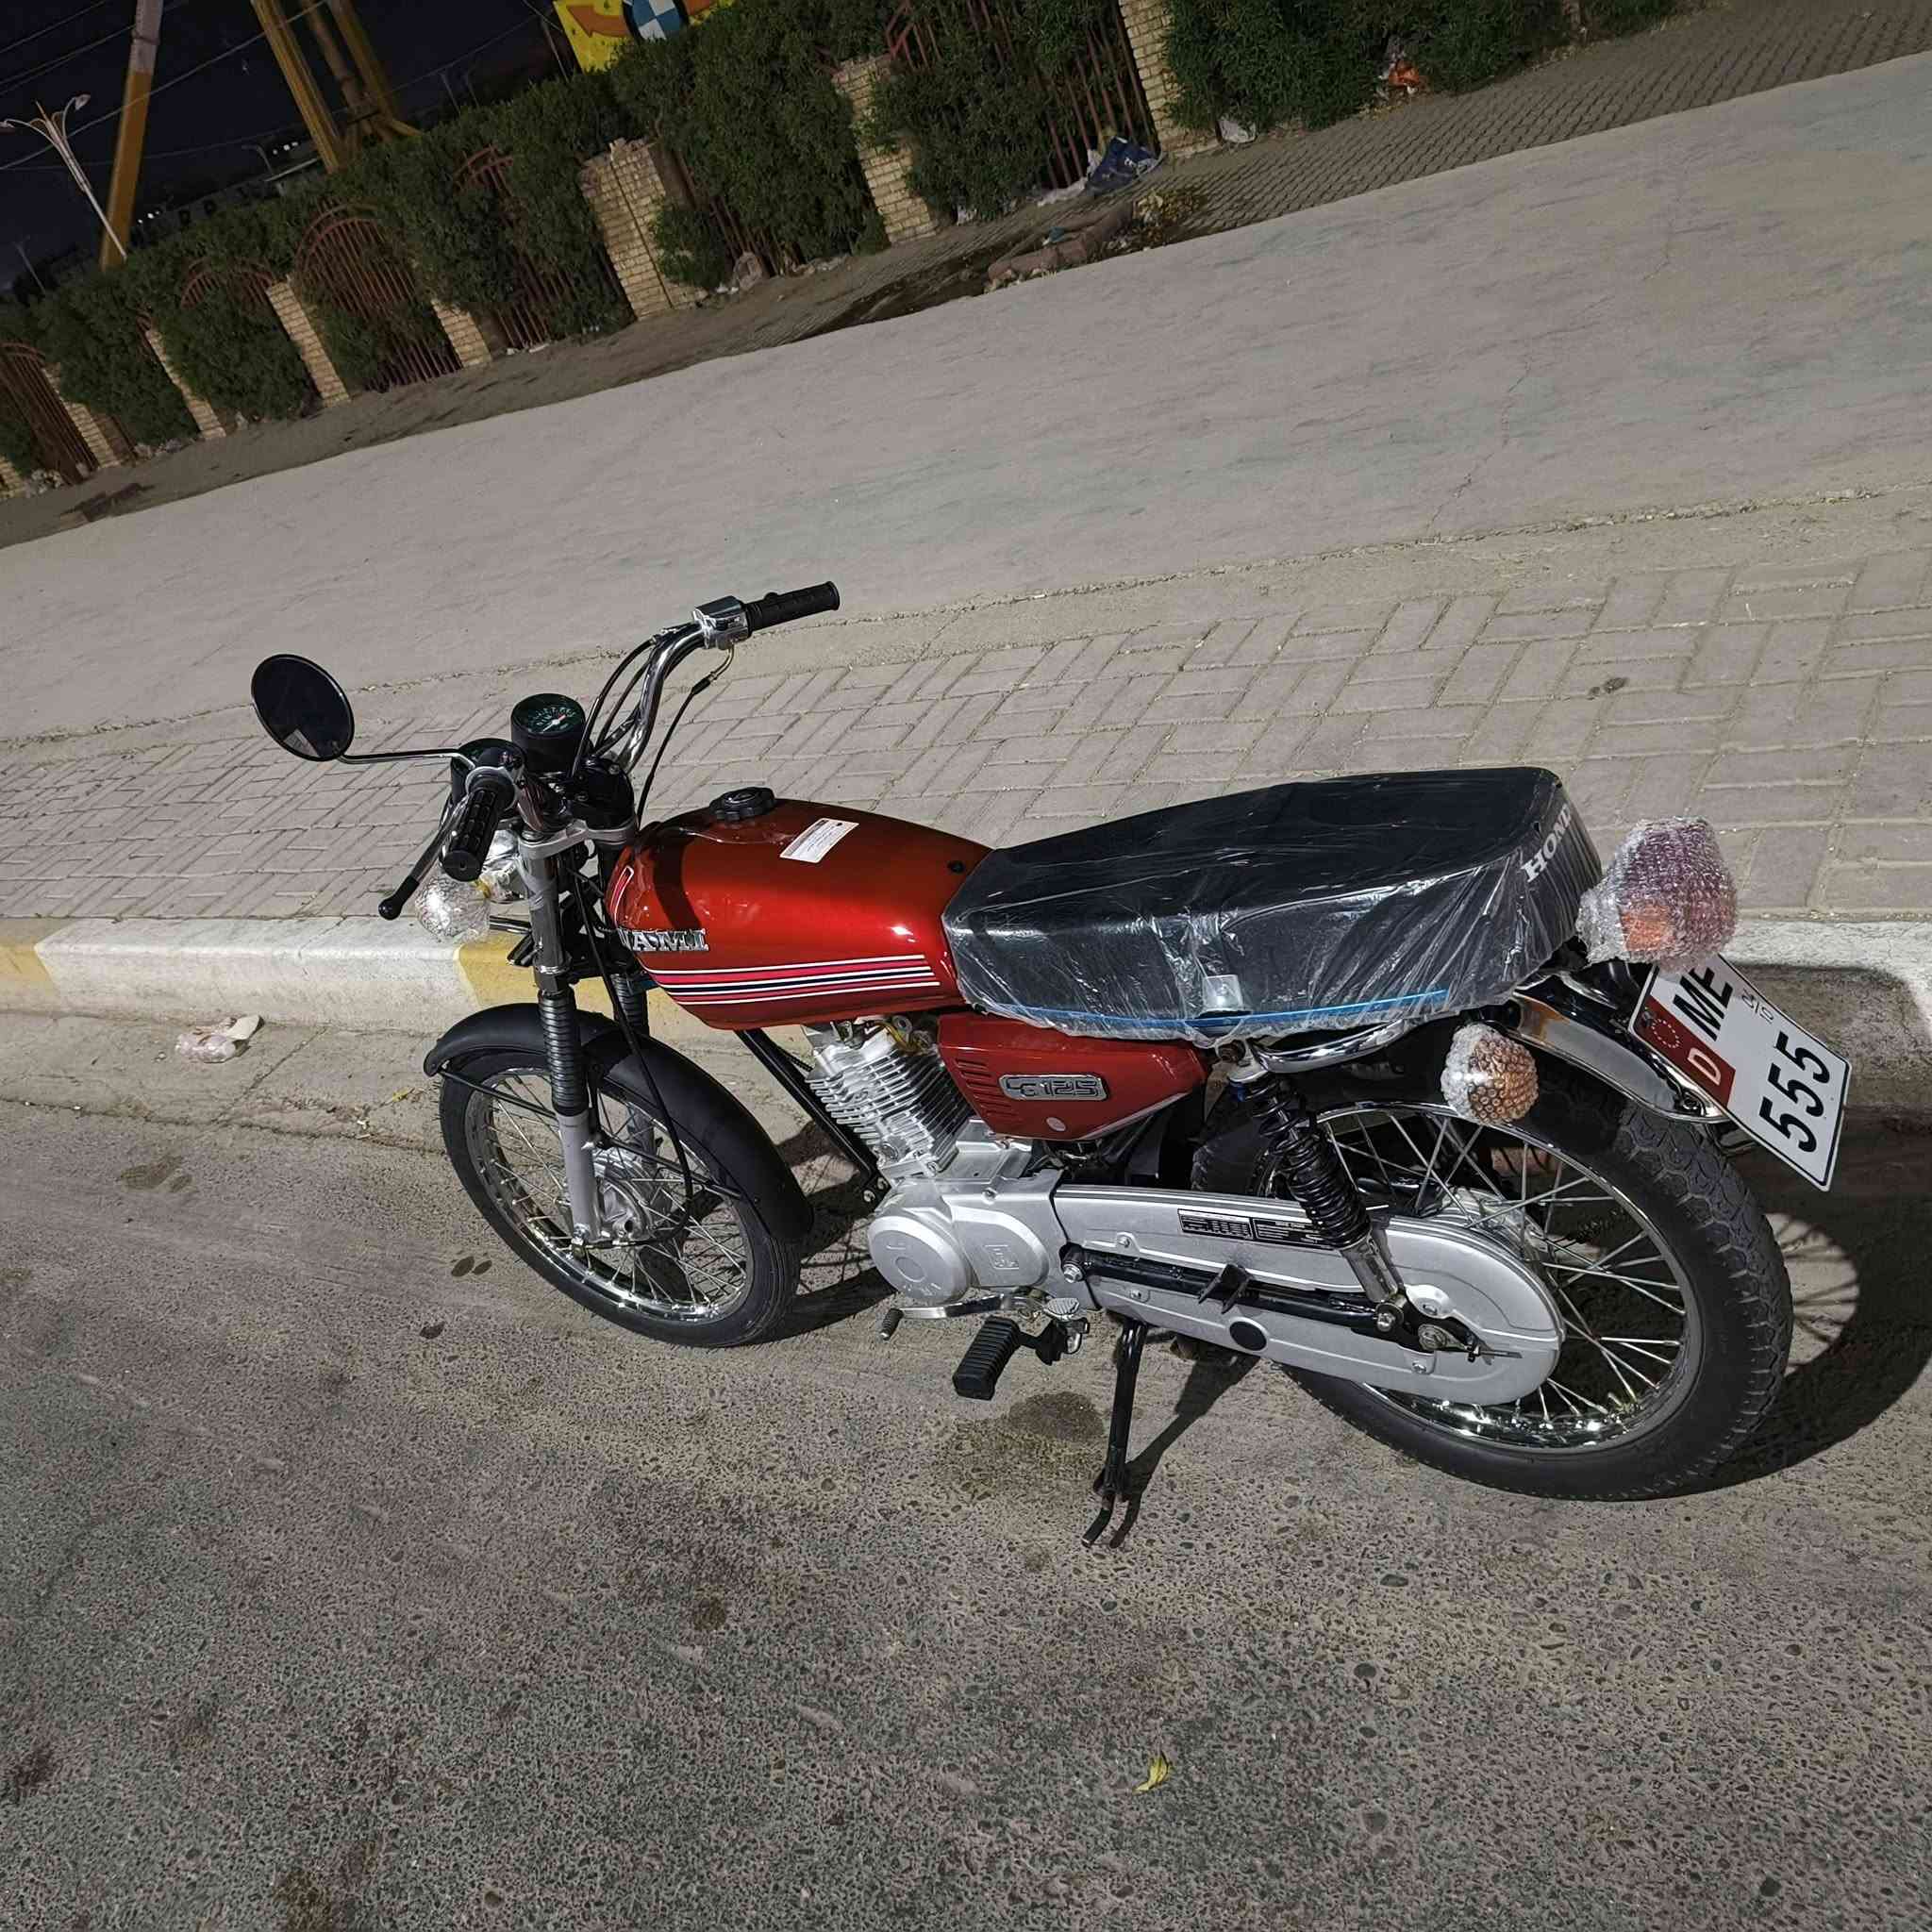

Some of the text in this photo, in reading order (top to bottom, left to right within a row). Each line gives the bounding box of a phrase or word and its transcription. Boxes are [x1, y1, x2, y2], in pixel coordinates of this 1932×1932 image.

[1673, 967, 1734, 1041] ME
[1687, 1047, 1722, 1086] D
[1759, 1031, 1831, 1154] 555
